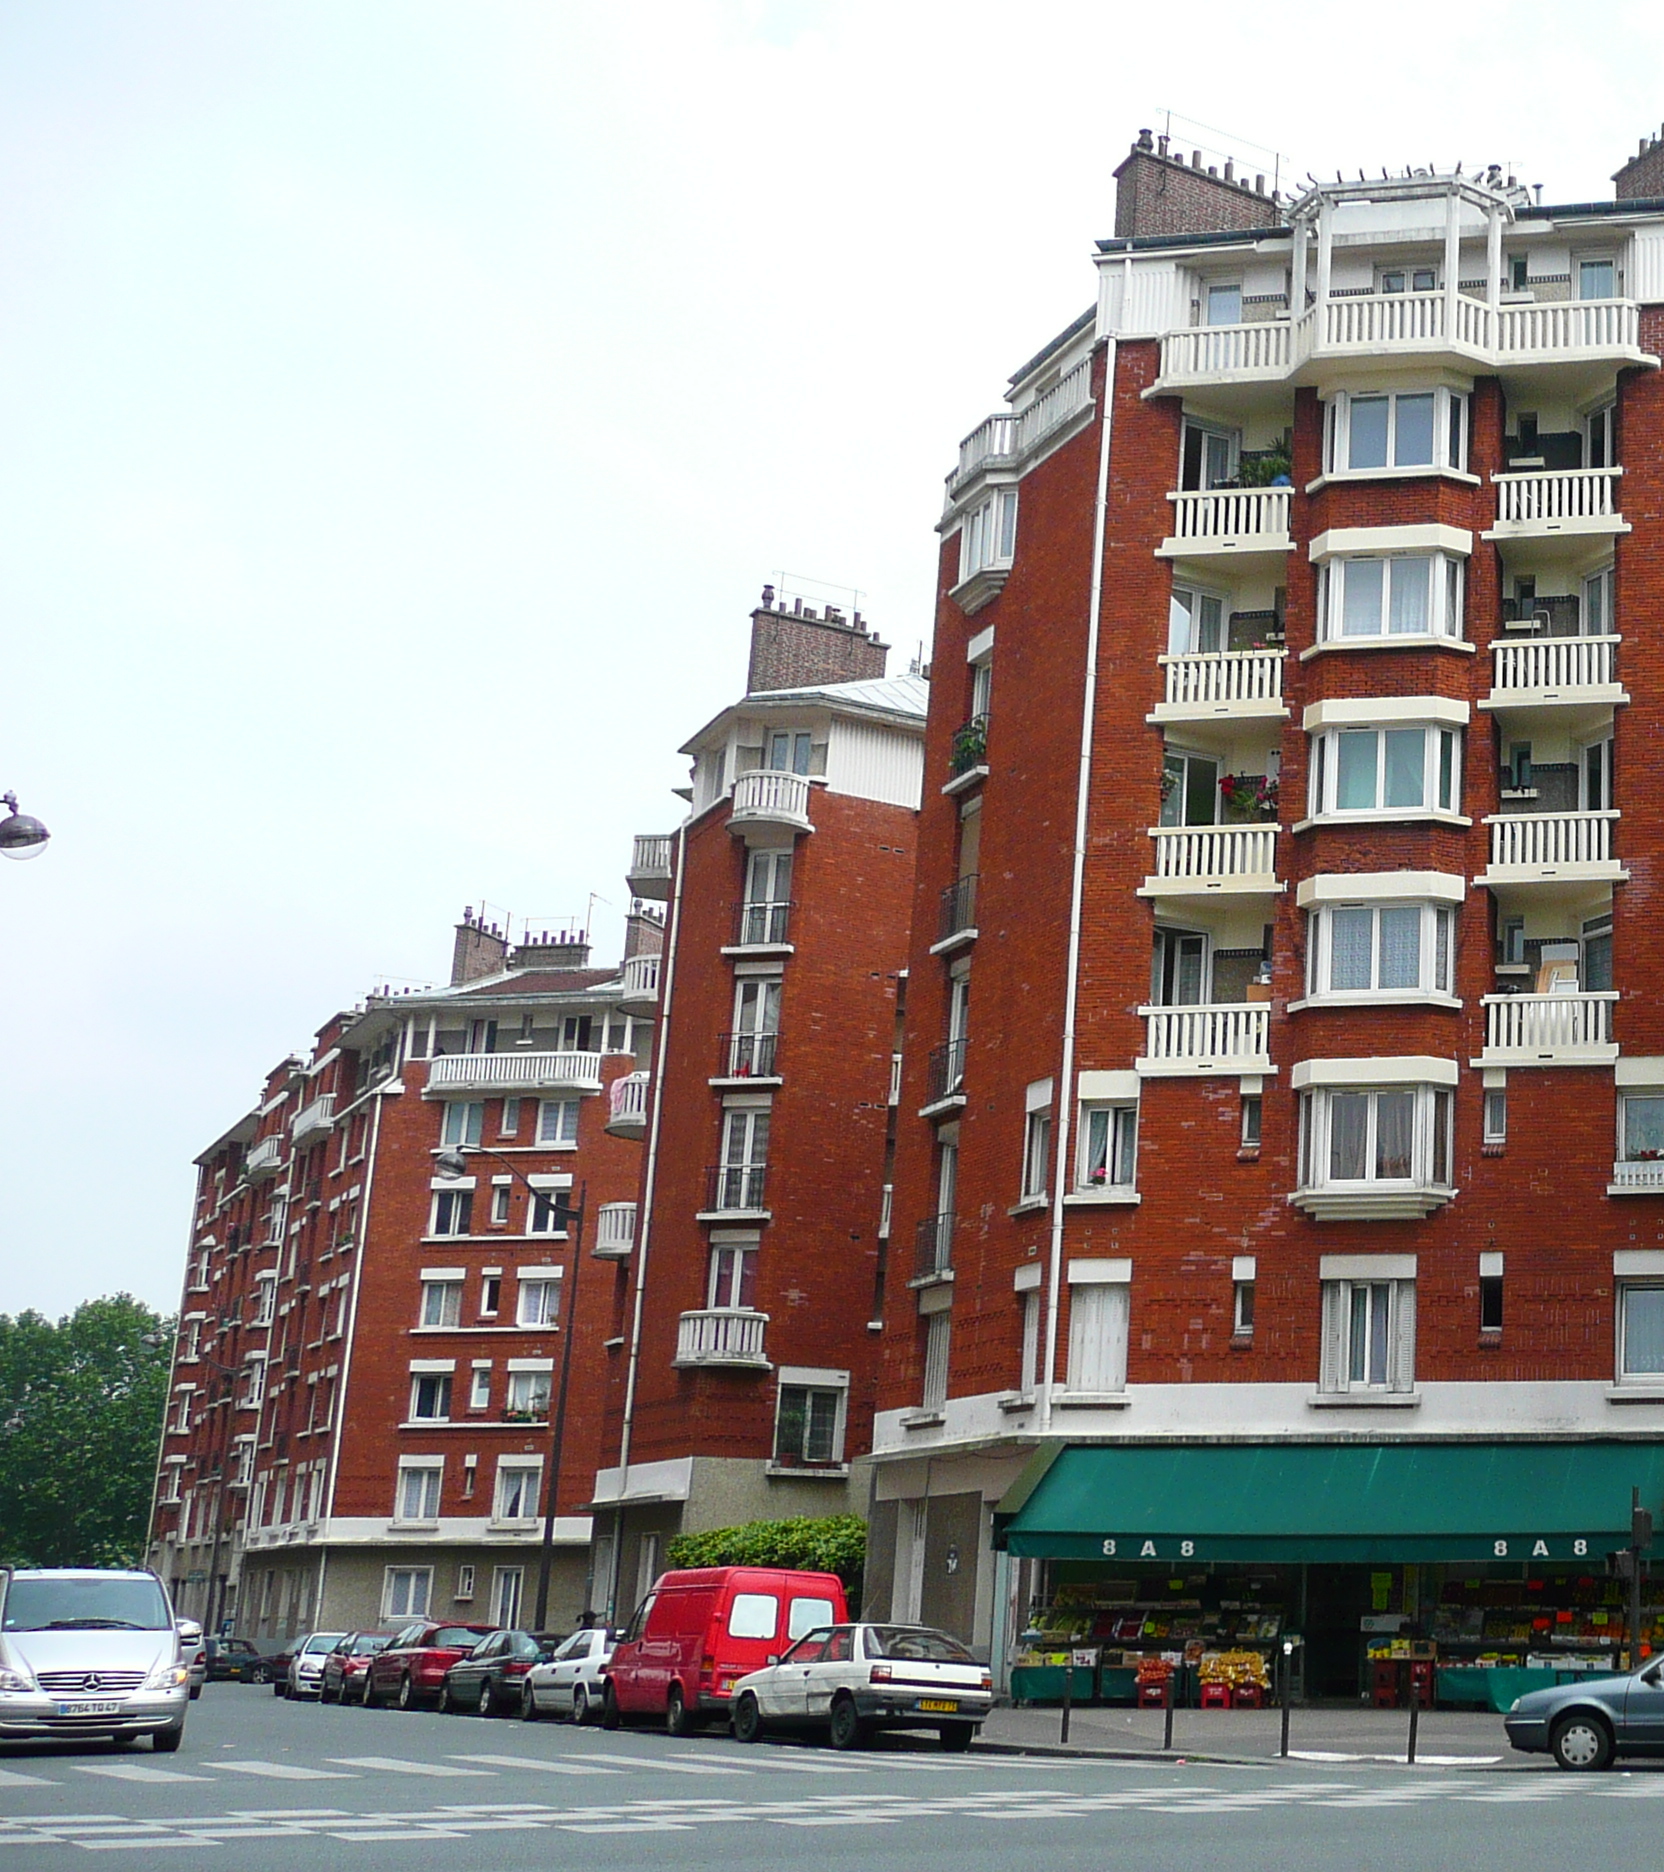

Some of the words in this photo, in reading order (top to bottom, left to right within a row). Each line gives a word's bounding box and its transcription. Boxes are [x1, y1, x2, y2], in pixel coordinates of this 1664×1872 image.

[1104, 1540, 1116, 1555] 8
[1141, 1540, 1156, 1556] A
[1181, 1541, 1194, 1556] 8
[1494, 1541, 1507, 1556] 8
[1533, 1541, 1549, 1556] A
[1574, 1540, 1587, 1555] 8
